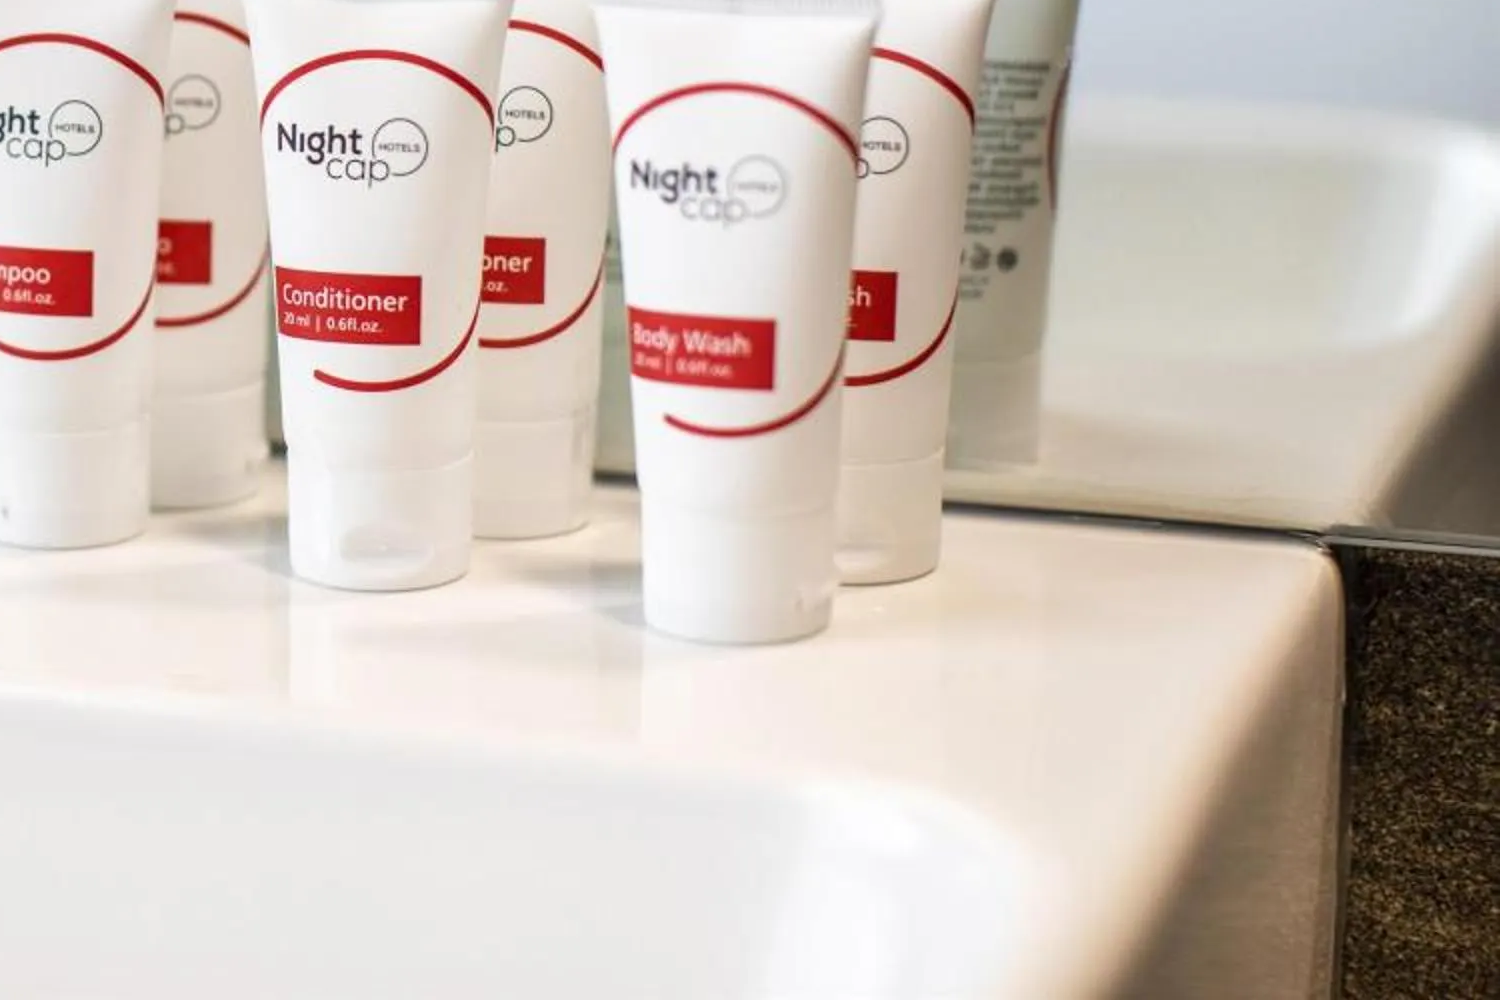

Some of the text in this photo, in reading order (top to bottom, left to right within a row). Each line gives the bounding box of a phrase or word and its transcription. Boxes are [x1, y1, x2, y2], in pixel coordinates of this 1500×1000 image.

[55, 122, 96, 134] HOTELS
[505, 109, 546, 121] HOTELS
[6, 137, 66, 168] cap
[277, 121, 363, 166] Night
[378, 142, 421, 153] HOTELS
[326, 158, 391, 189] cap
[630, 159, 717, 204] Night
[282, 282, 409, 312] Conditioner
[632, 322, 753, 357] Body Wash
